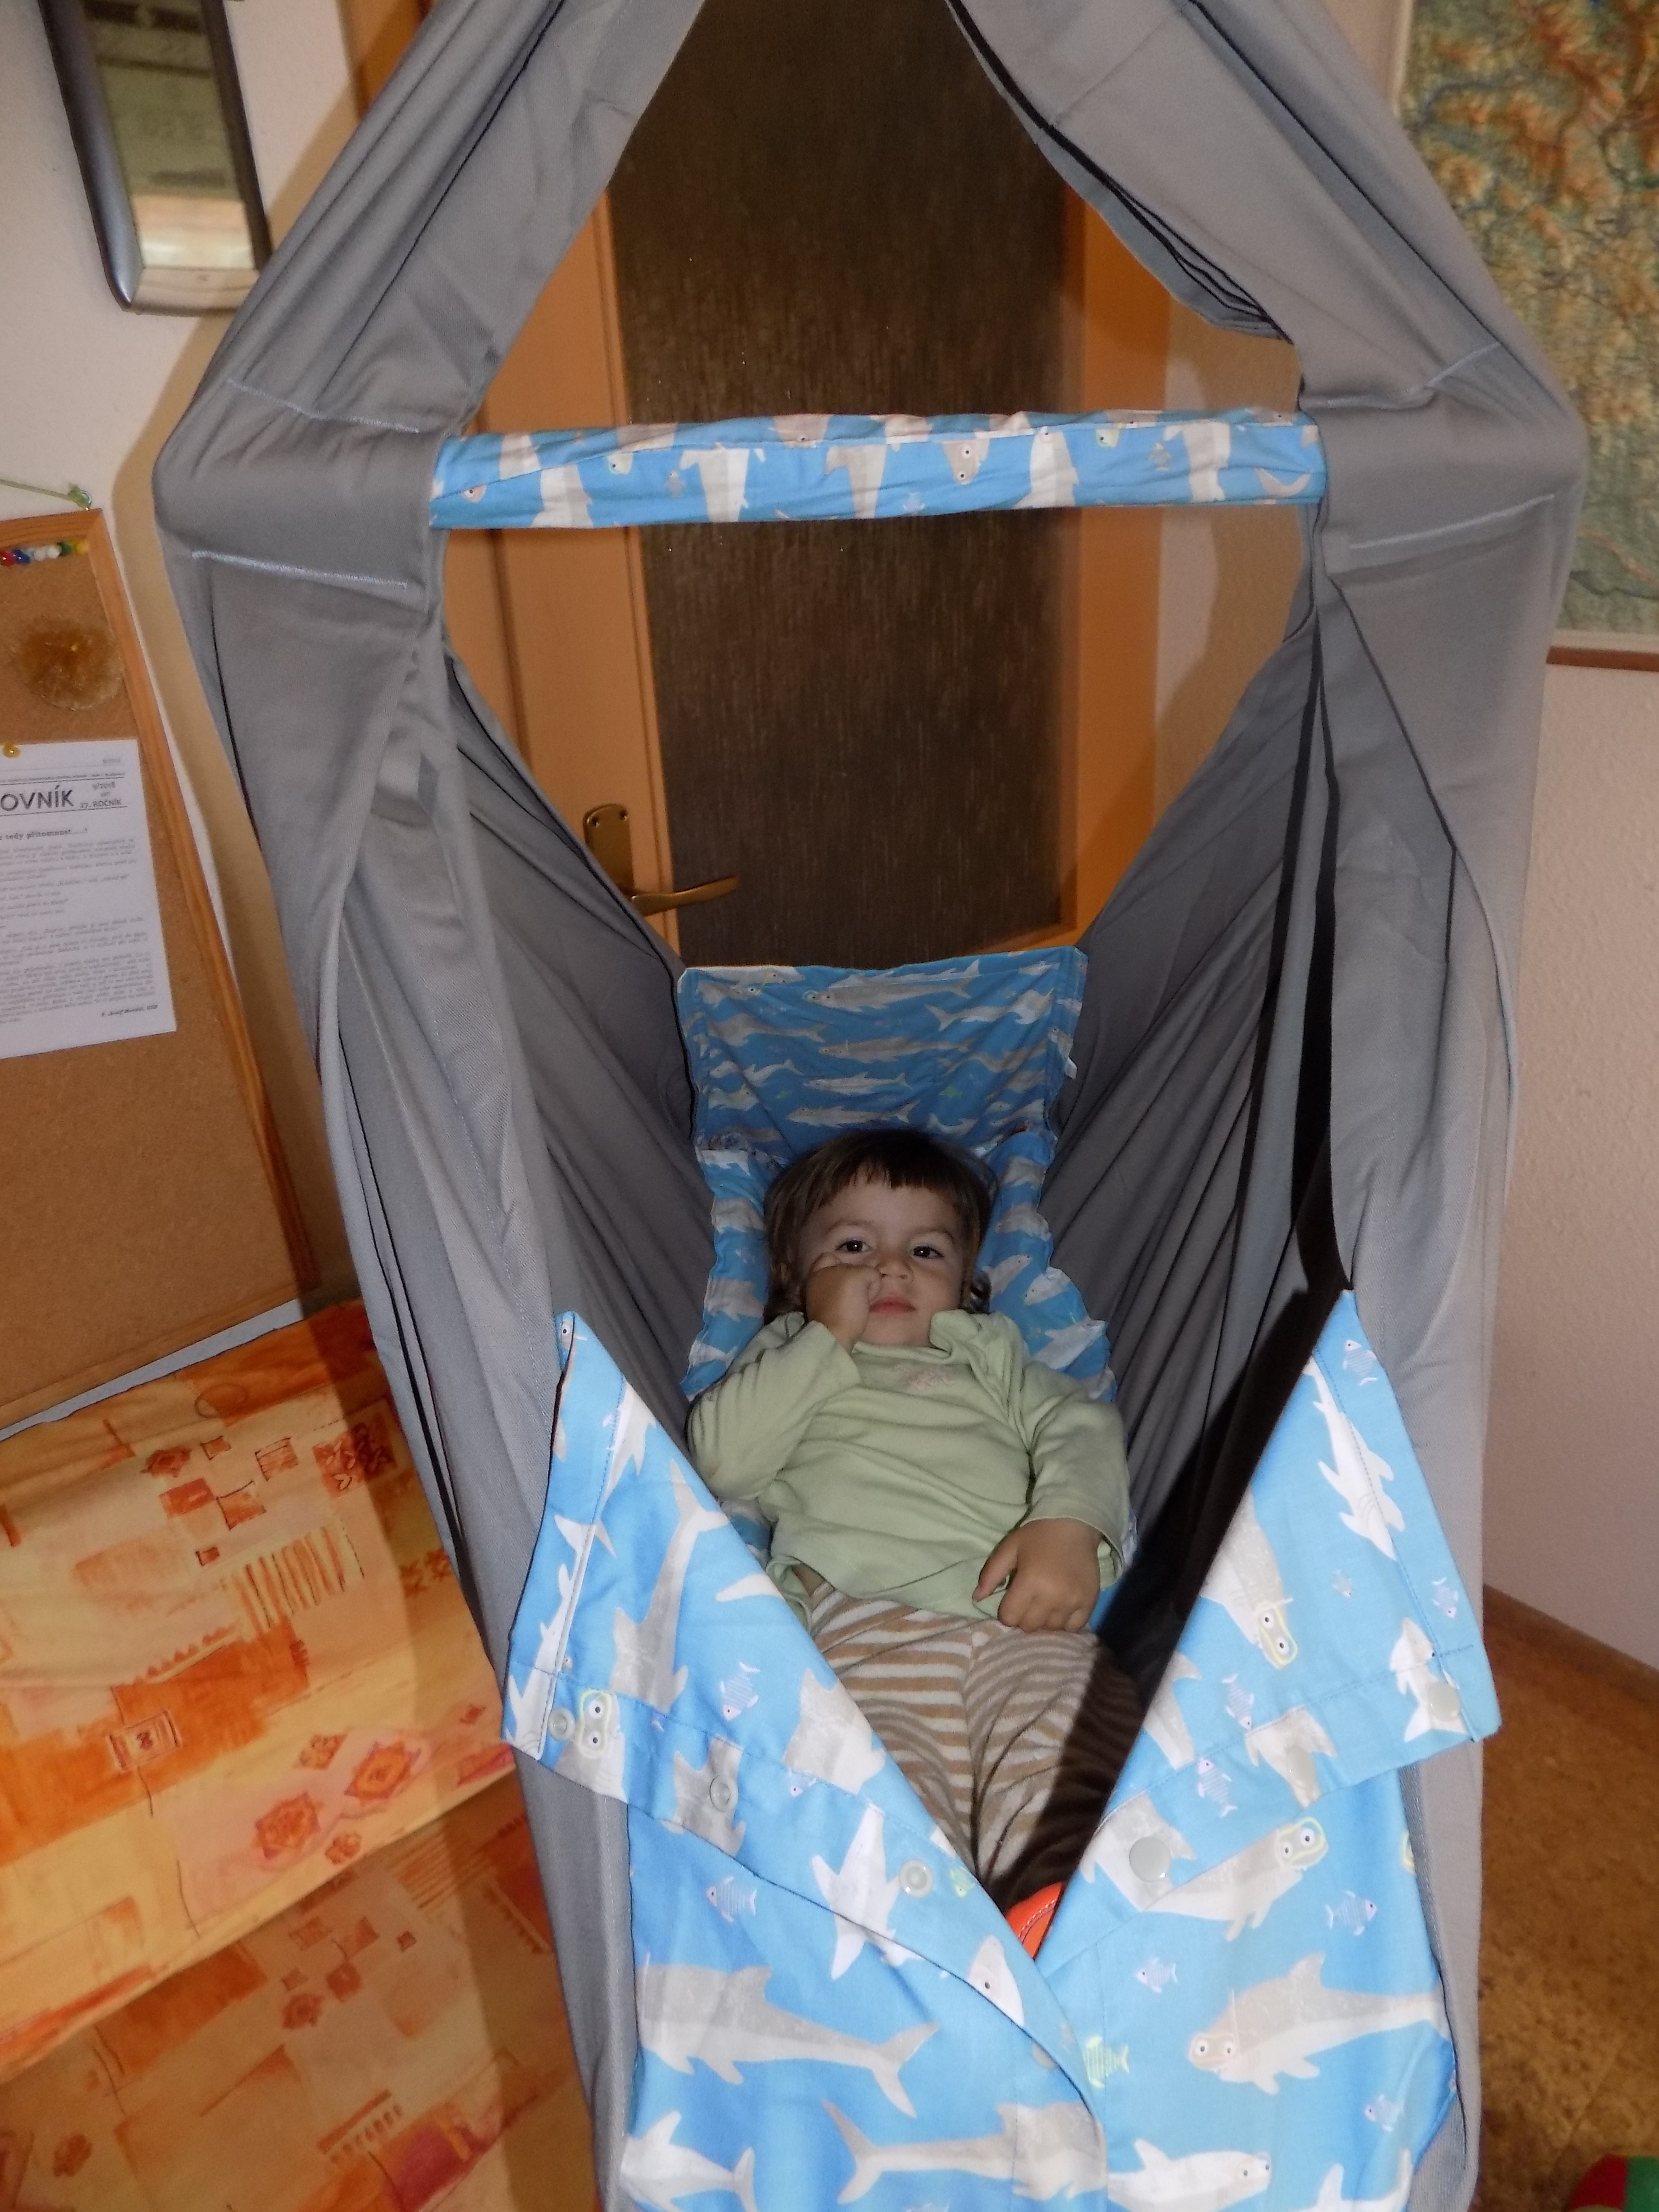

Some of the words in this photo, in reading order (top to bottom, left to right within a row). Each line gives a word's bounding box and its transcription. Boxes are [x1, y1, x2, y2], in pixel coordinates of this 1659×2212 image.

[92, 781, 116, 791] 9/2018
[0, 785, 74, 811] OVNÍK
[93, 799, 122, 808] ROČNÍK
